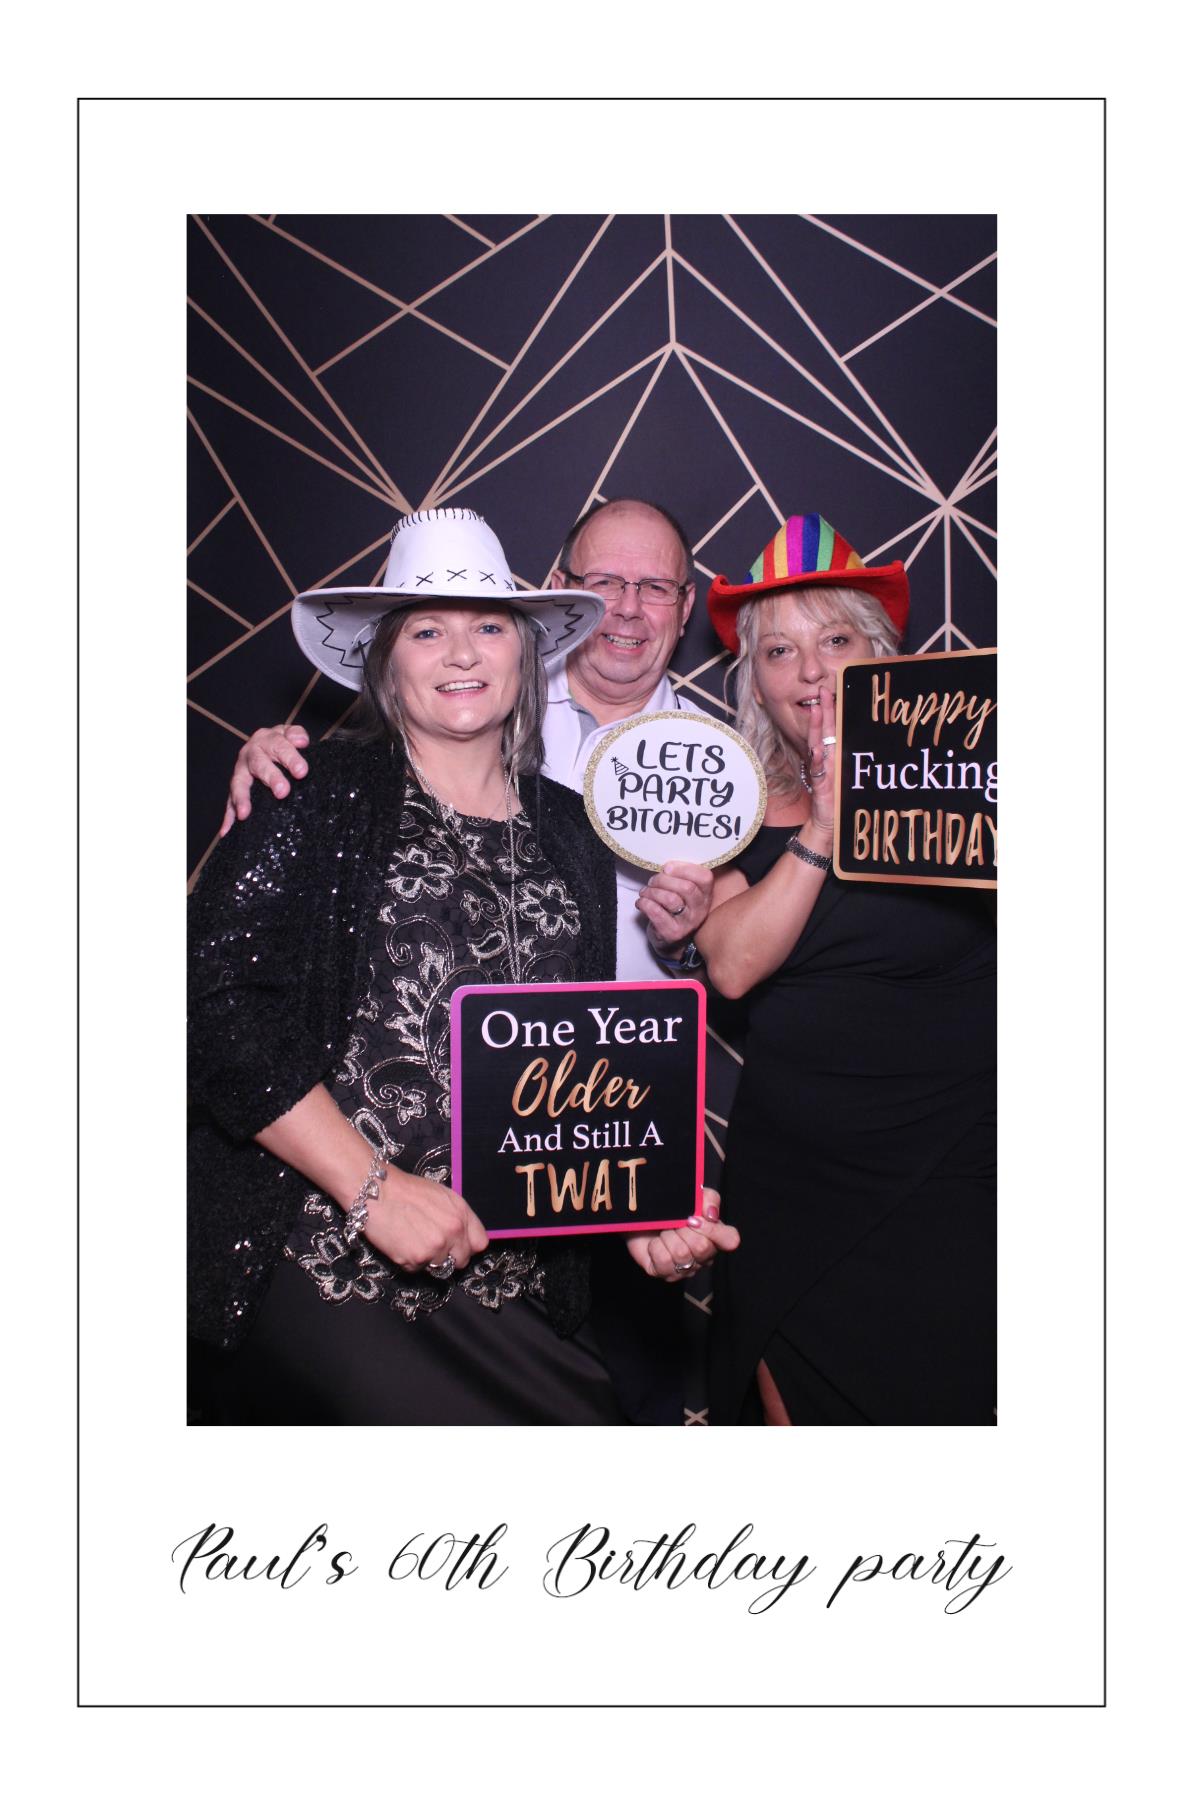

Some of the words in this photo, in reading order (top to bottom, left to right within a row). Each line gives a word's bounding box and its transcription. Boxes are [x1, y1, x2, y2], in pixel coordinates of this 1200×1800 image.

[871, 671, 997, 750] Happy
[636, 739, 726, 775] LETS
[617, 772, 734, 808] PARTY
[606, 805, 742, 841] BITCHES!
[481, 1010, 575, 1048] One
[587, 1007, 683, 1045] Year
[511, 1049, 651, 1118] Older
[497, 1123, 563, 1153] And
[572, 1121, 631, 1149] Still
[639, 1120, 664, 1146] A
[514, 1157, 647, 1217] TWAT
